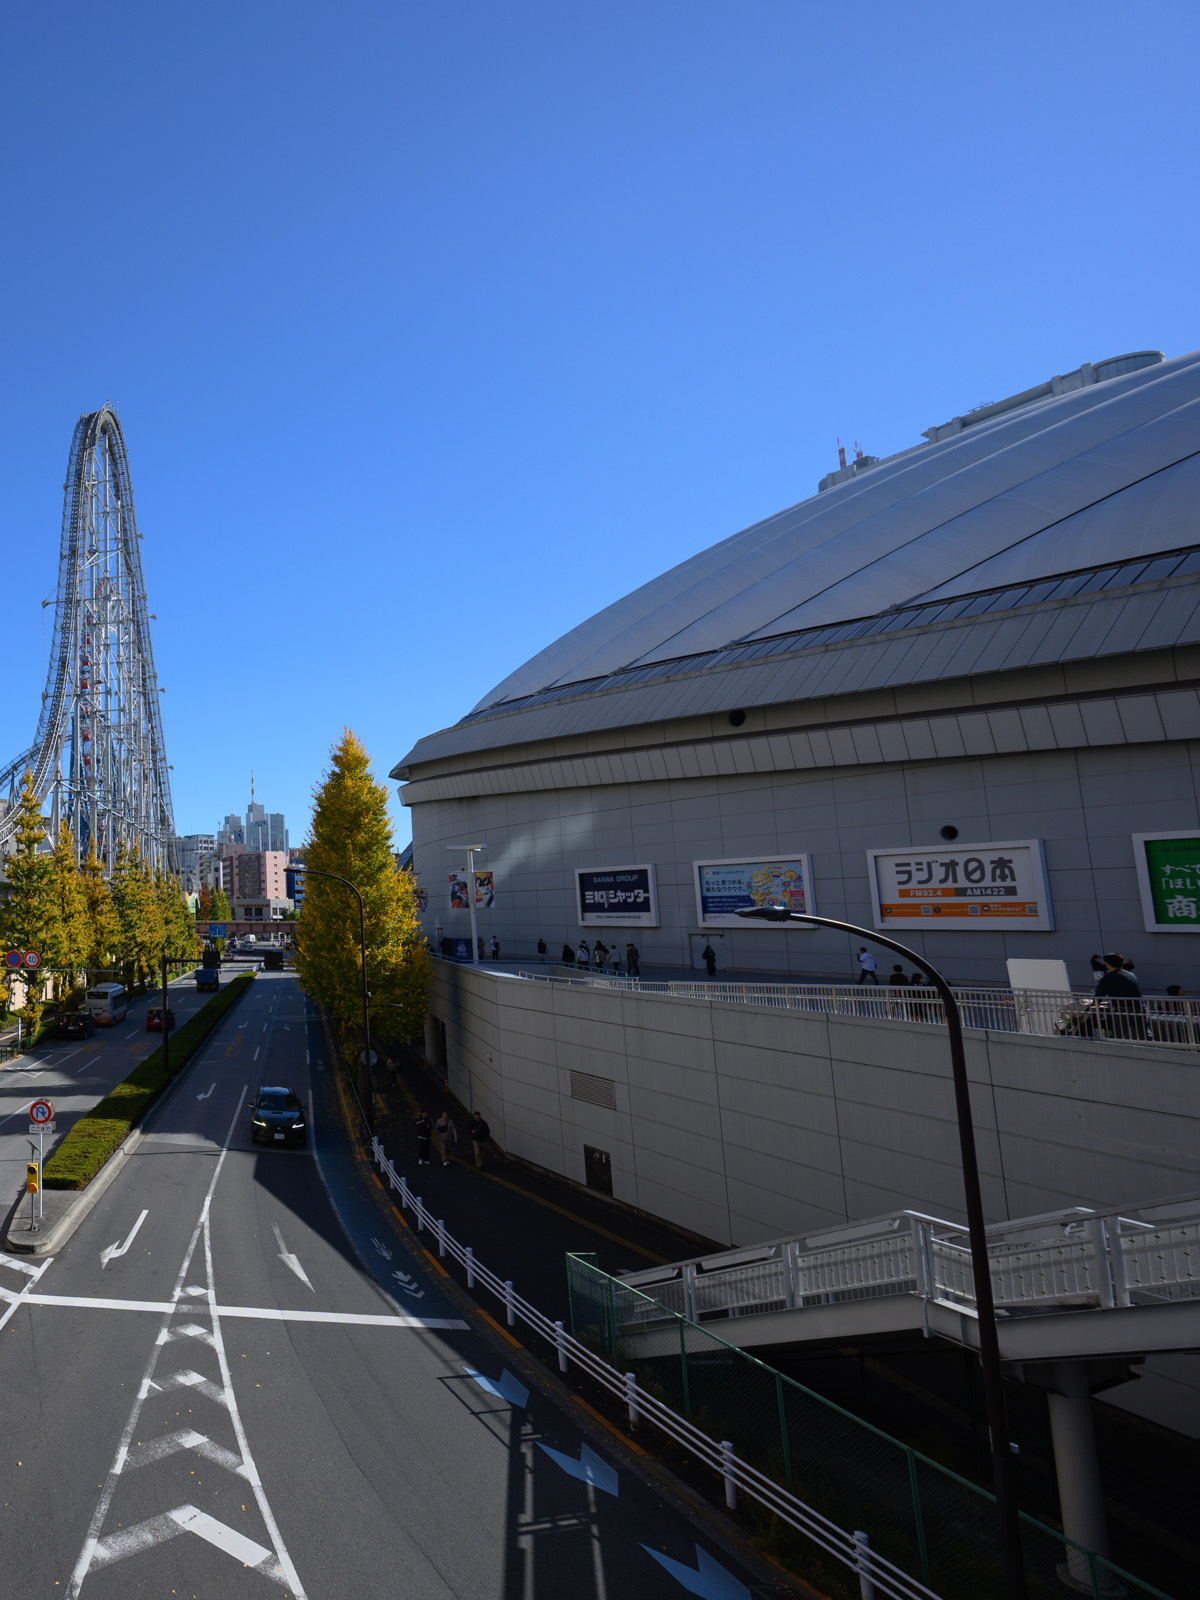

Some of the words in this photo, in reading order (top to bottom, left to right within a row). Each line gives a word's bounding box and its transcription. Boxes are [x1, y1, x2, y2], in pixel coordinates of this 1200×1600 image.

[894, 856, 1017, 886] ラジオ日本
[592, 874, 615, 884] SANWA
[615, 874, 639, 882] GROUP
[1160, 877, 1200, 891] 「ほし
[909, 888, 943, 897] FM92.4
[966, 887, 1006, 897] AM1422
[1163, 894, 1200, 919] 商
[27, 955, 38, 964] 40
